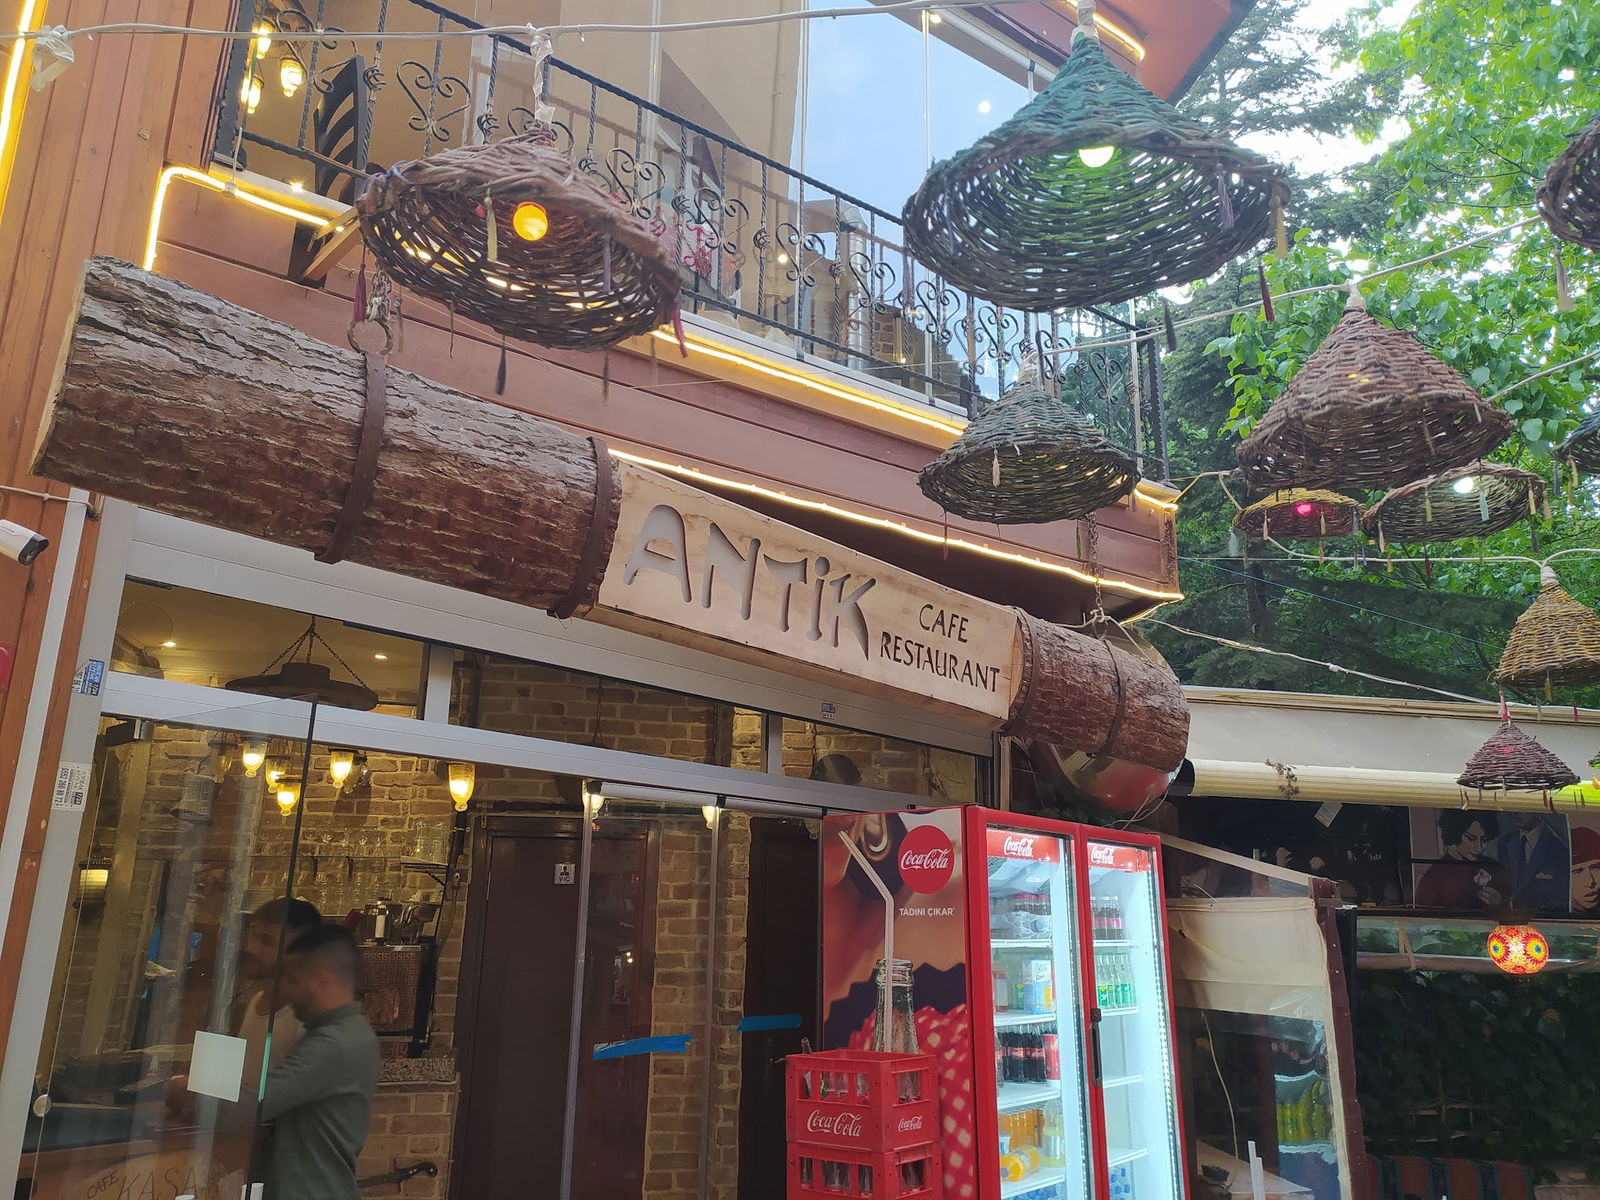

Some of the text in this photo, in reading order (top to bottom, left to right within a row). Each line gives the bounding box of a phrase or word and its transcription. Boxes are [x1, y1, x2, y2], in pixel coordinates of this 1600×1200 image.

[918, 602, 970, 644] CAFE
[880, 630, 1001, 694] RESTAURANT
[900, 848, 952, 871] Coca-Cola
[898, 907, 926, 917] TADINI
[807, 1109, 863, 1138] Coca-Cola
